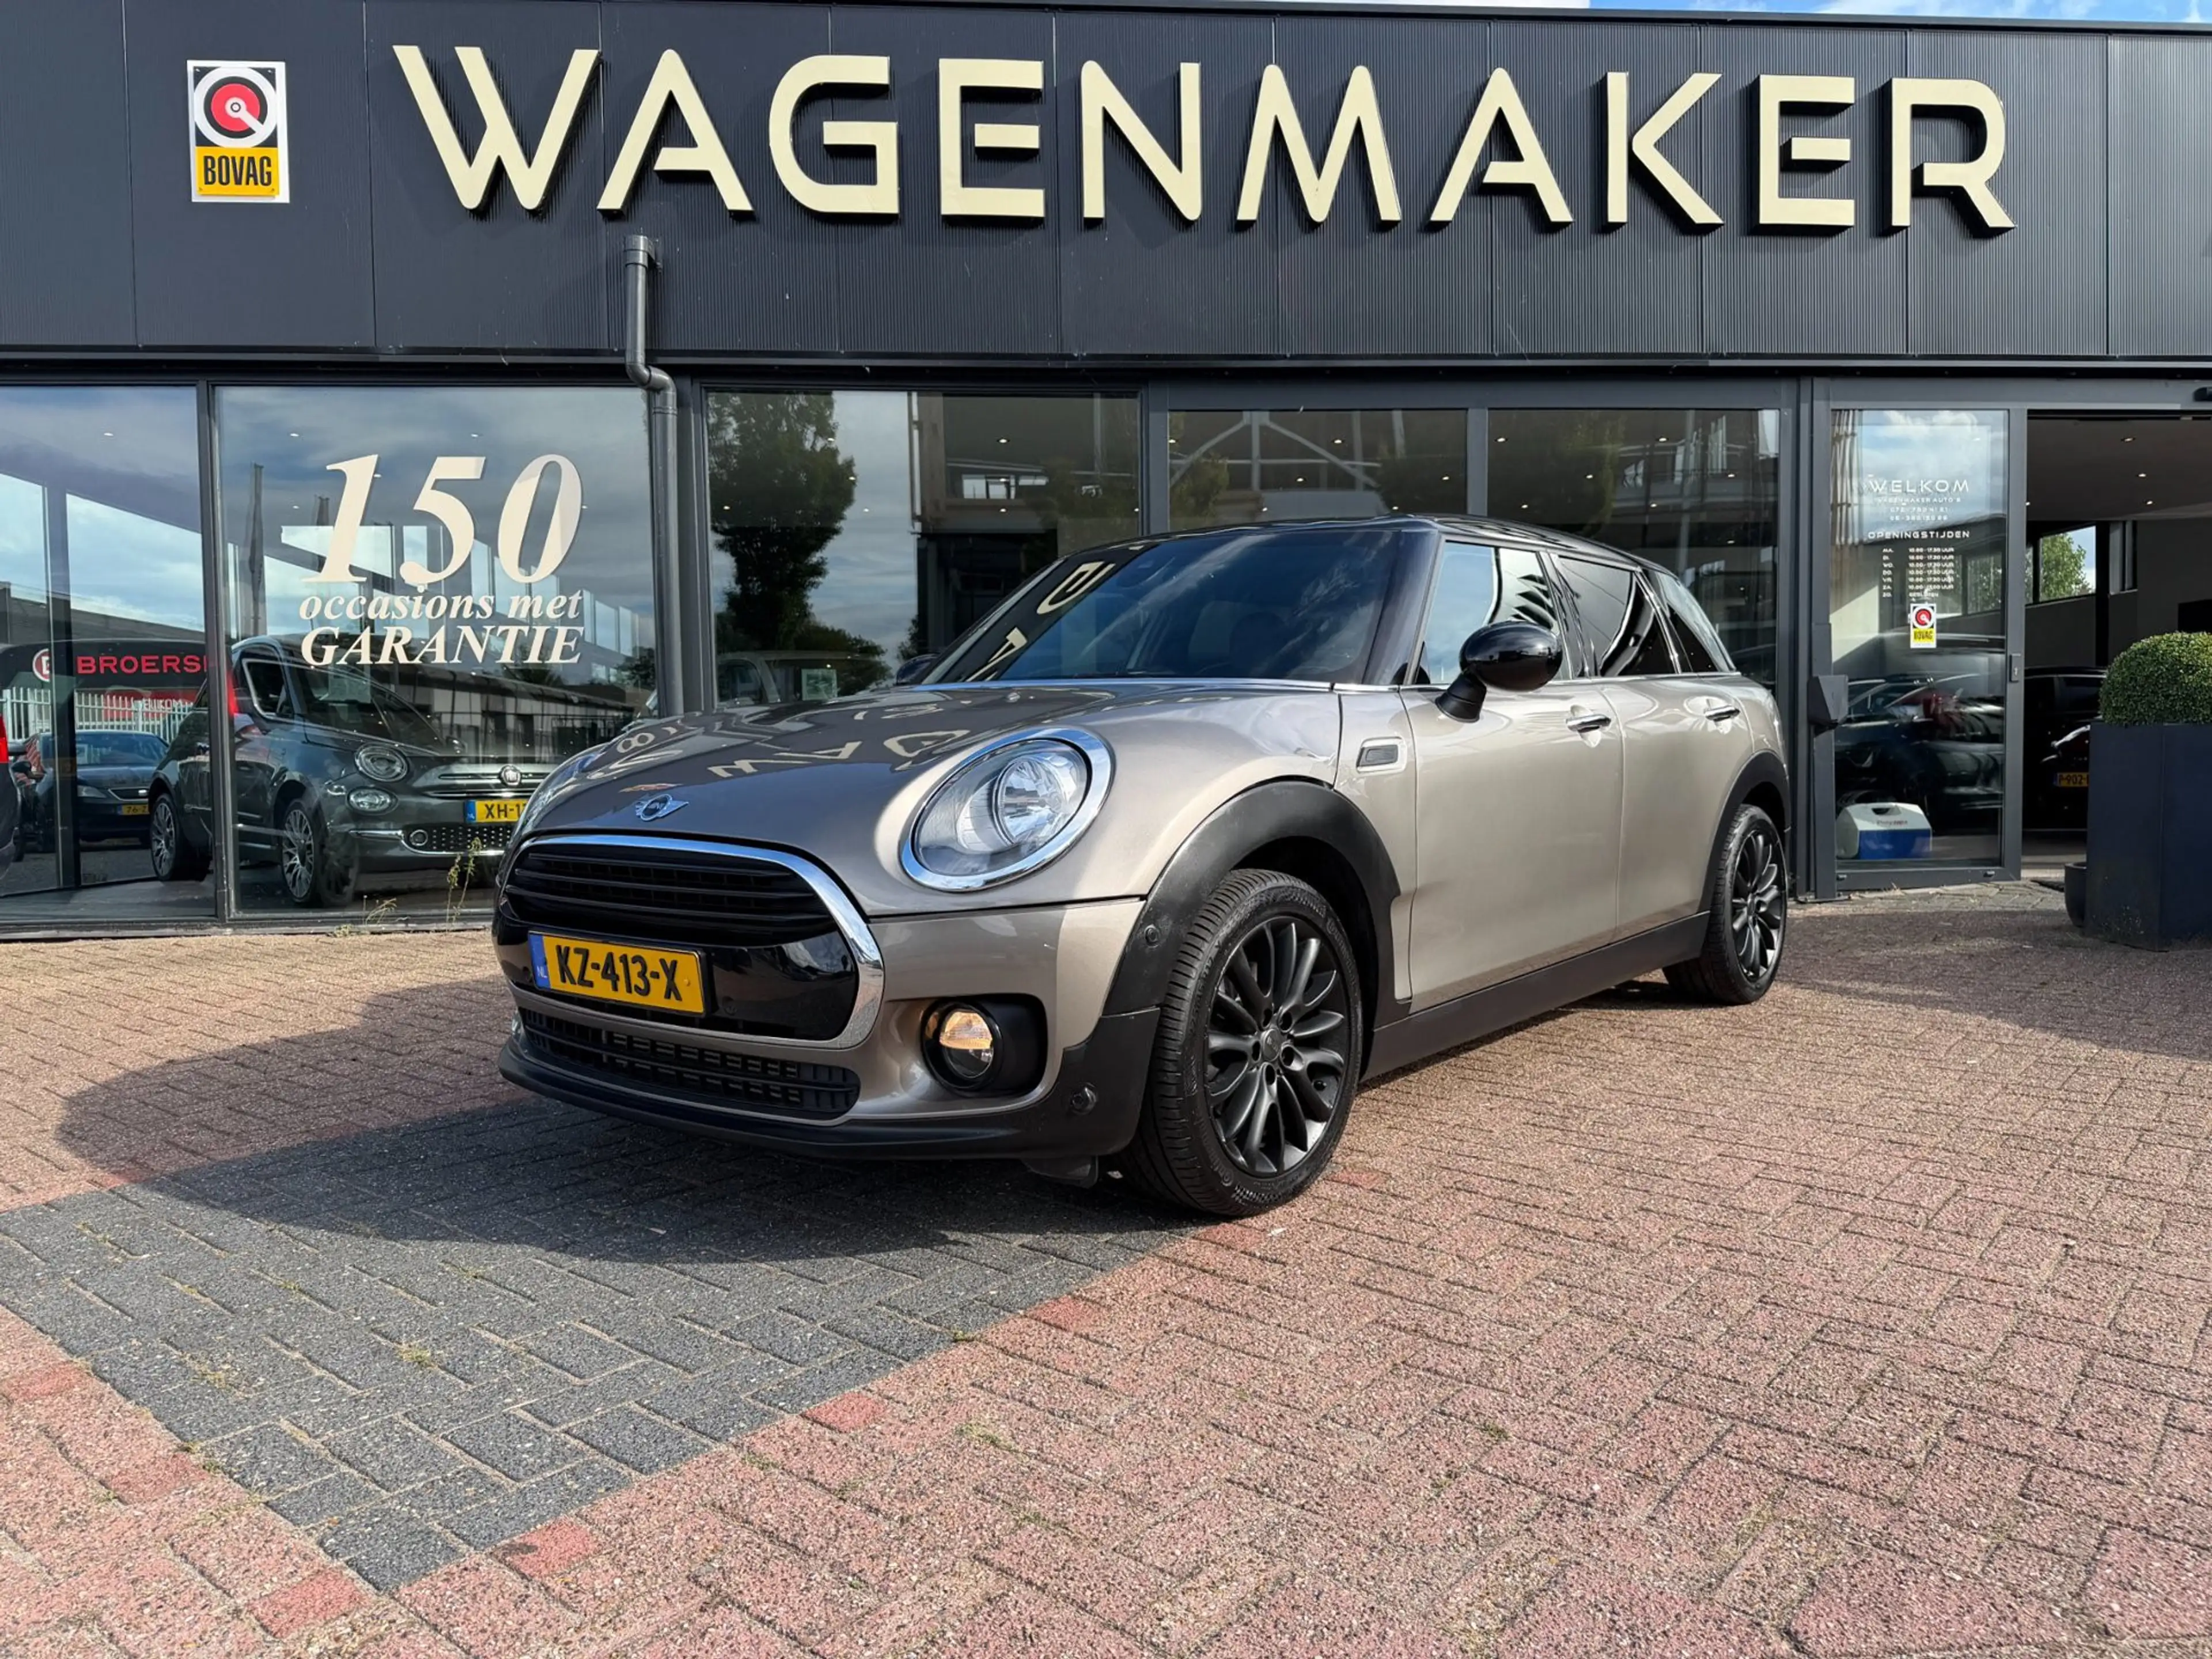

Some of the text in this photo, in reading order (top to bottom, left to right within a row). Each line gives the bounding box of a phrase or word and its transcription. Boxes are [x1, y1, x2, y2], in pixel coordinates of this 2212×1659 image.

[392, 46, 2016, 229] WAGENMAKER
[203, 155, 272, 186] BOVAG
[1869, 480, 1969, 493] WELKOM
[301, 454, 582, 584] 150
[1868, 531, 1970, 539] OPENINGSTIJDEN
[298, 585, 584, 620] occasions met
[301, 624, 585, 666] GARANTIE
[555, 945, 683, 1002] KZ-413-X
